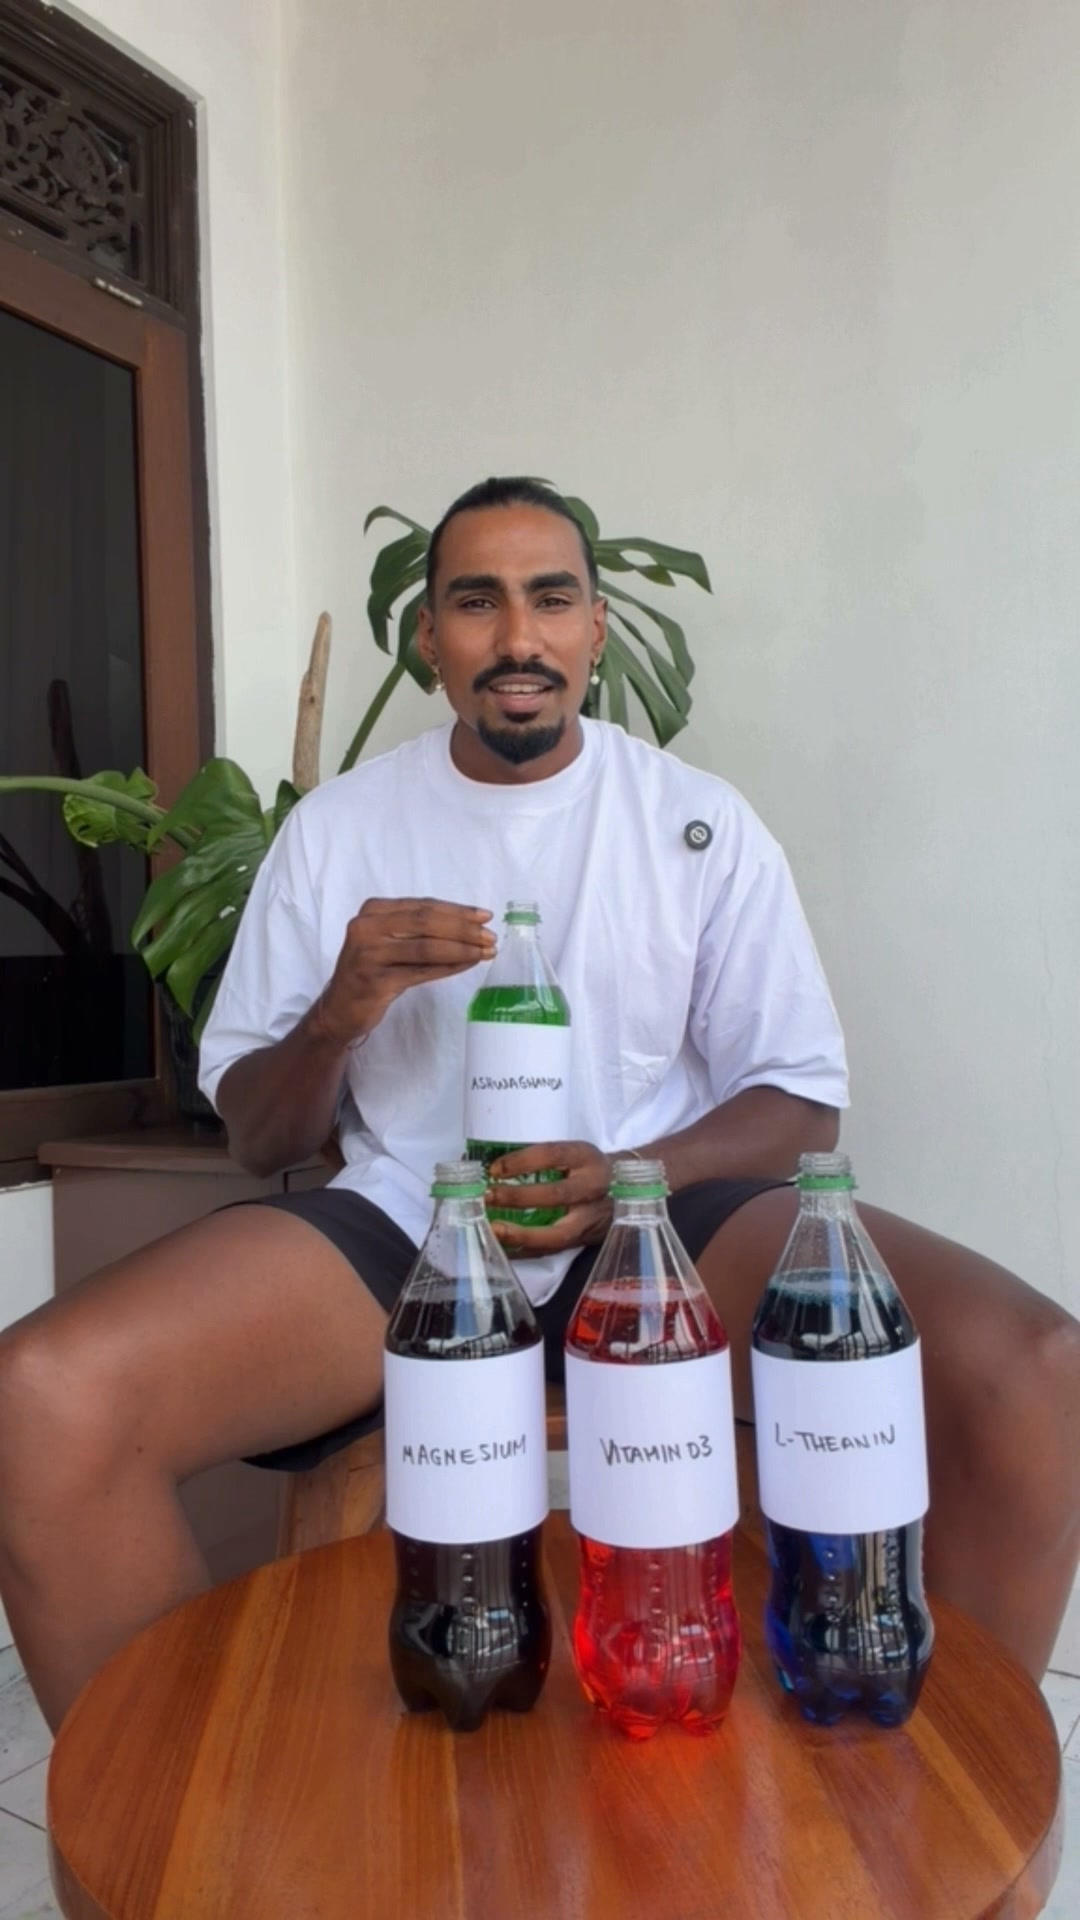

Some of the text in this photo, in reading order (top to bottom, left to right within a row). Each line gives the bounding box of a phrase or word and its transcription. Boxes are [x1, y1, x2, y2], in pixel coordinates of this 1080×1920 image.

[402, 1433, 526, 1466] MAGNESIUM
[599, 1434, 713, 1466] VITAMIN D3
[774, 1421, 896, 1452] L-THEANIN
